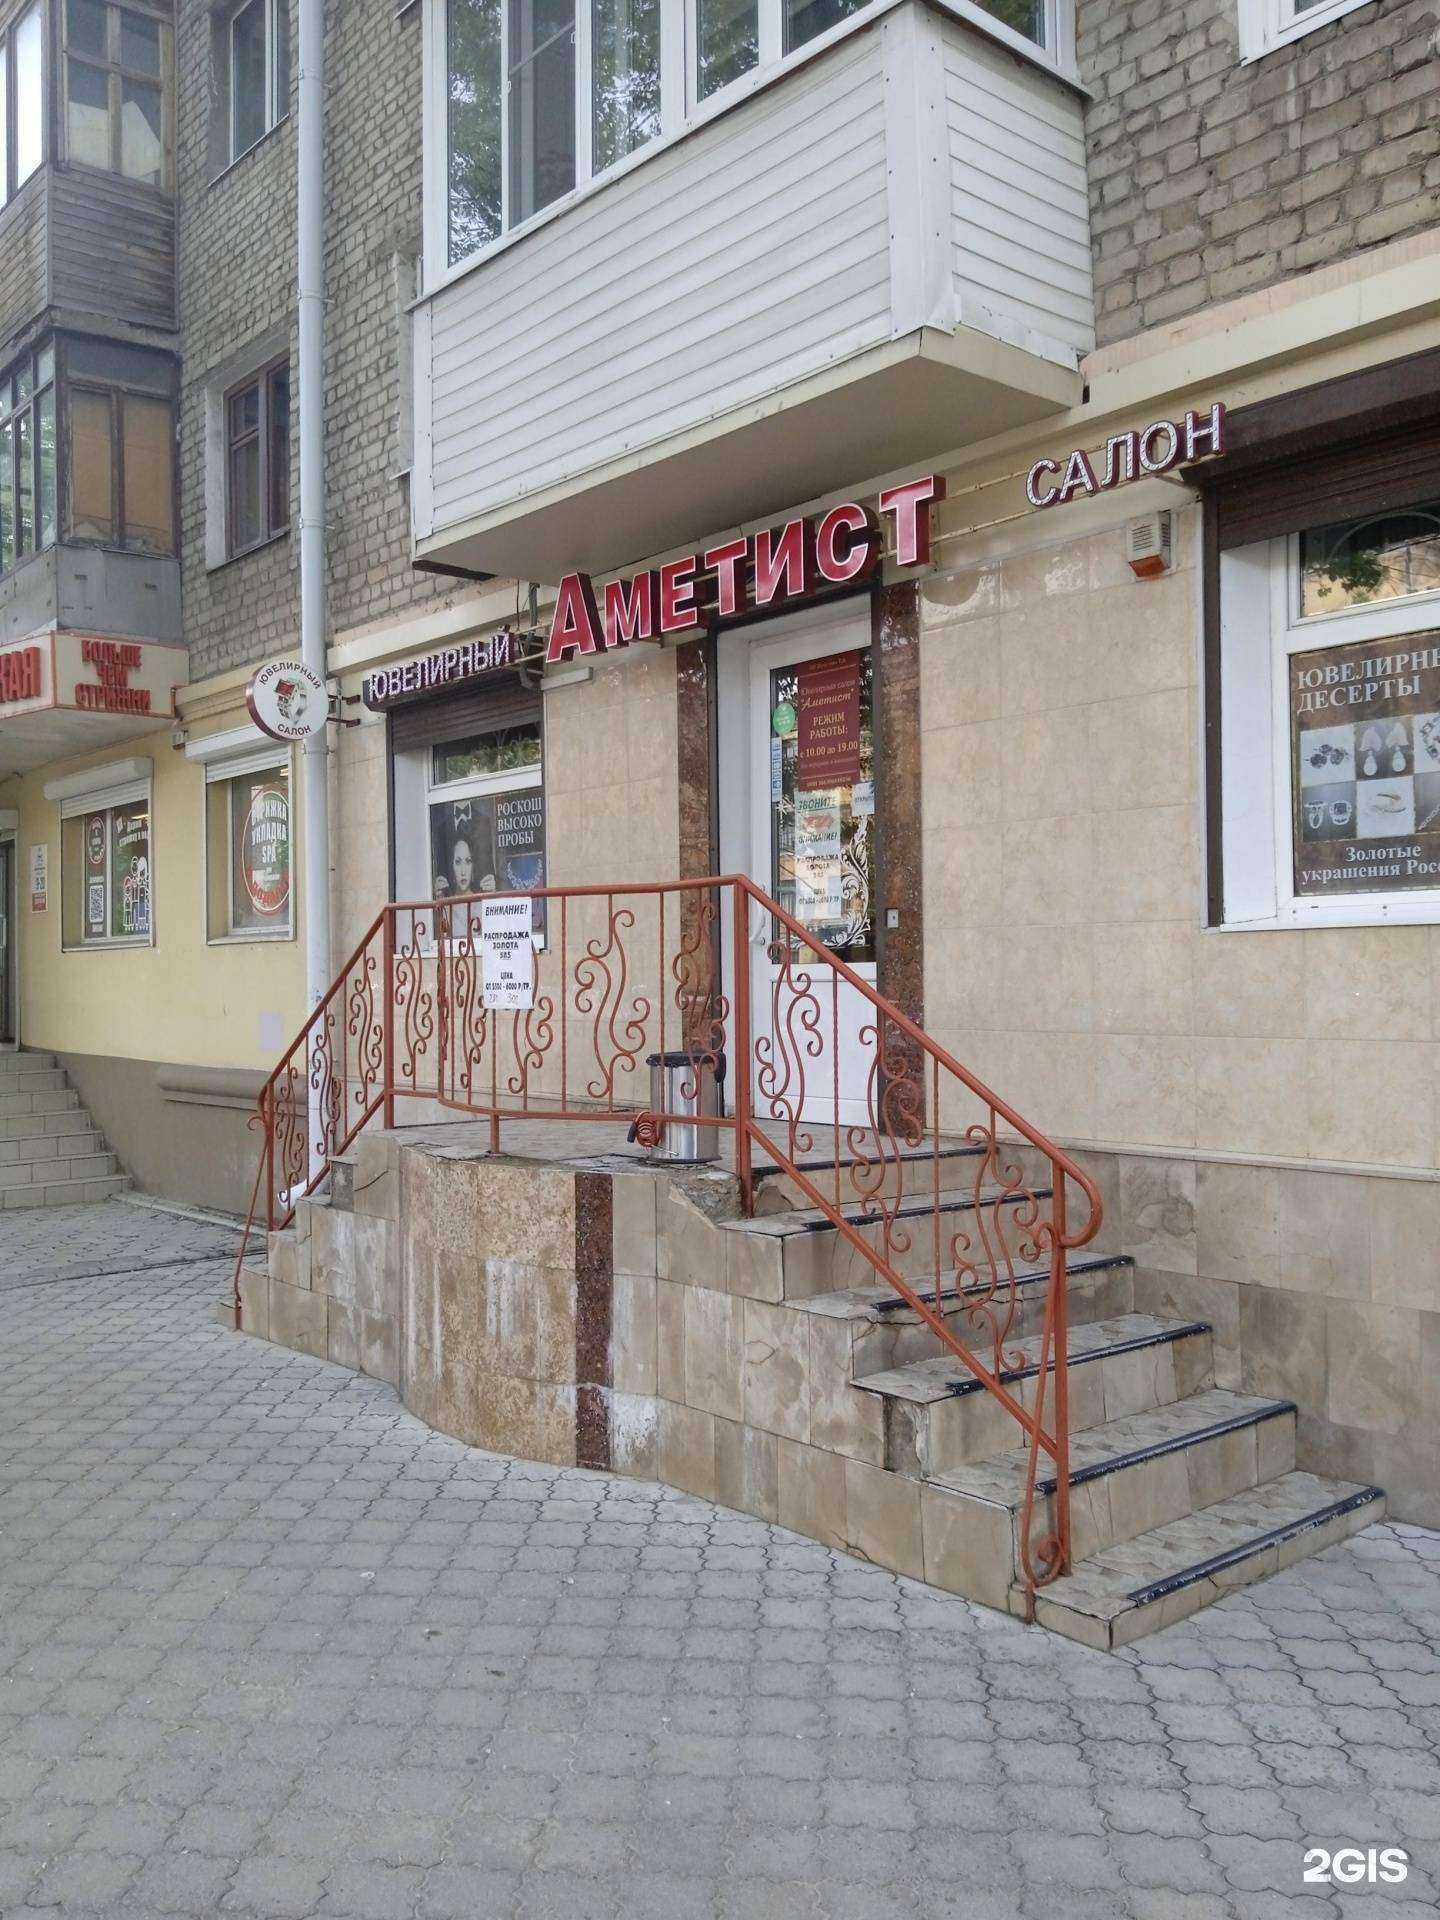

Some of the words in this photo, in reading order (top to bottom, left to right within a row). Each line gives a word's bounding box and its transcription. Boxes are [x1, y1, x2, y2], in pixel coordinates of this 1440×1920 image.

[1026, 402, 1222, 507] САЛОН
[546, 475, 941, 664] АМЕТИСТ
[81, 640, 142, 669] БОЛЬШЕ
[96, 663, 128, 688] ЧЕМ
[368, 630, 511, 702] ЮВЕЛИРНЫЙ
[260, 662, 322, 690] ЮВЕЛИРНЫЙ
[1297, 676, 1421, 713] ДЕСЕРТЫ
[813, 712, 845, 726] РЕЖИМ
[277, 723, 312, 735] САЛОН
[810, 726, 848, 740] РАБОТЫ:
[806, 746, 826, 757] 10.00
[838, 740, 858, 753] 19.00
[498, 813, 542, 832] ВЫСОКО
[498, 831, 534, 848] ПРОБЫ
[262, 844, 277, 863] SPA
[1346, 845, 1422, 863] Золотые
[1302, 862, 1401, 885] украшения
[485, 904, 528, 917] ВНИМАНИЕ!
[484, 931, 529, 941] РАСПРОДАЖА
[493, 941, 519, 949] ЗОЛОТА
